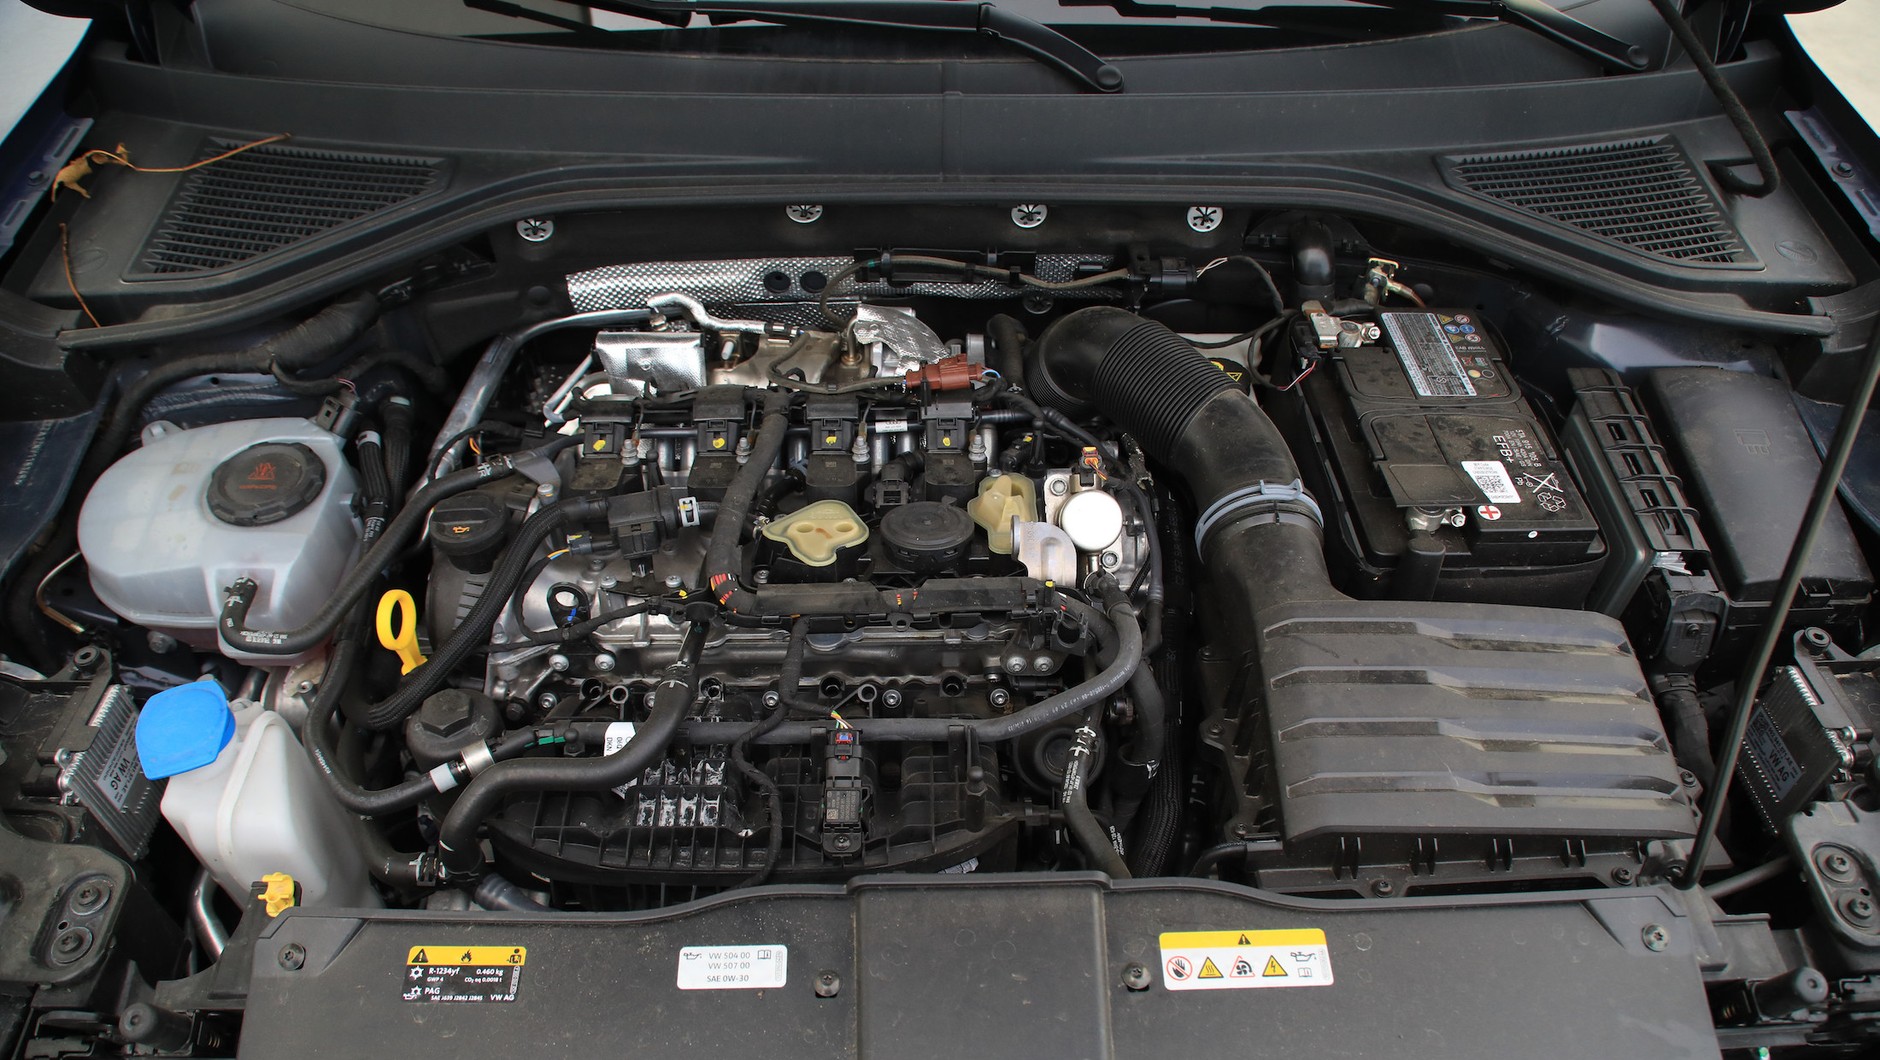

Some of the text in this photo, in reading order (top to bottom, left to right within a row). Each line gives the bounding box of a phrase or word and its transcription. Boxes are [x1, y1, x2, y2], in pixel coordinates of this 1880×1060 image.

[1493, 435, 1515, 464] EFB+
[110, 758, 130, 791] VW AG
[1769, 750, 1789, 781] VW AG
[428, 967, 460, 976] R-1234yf
